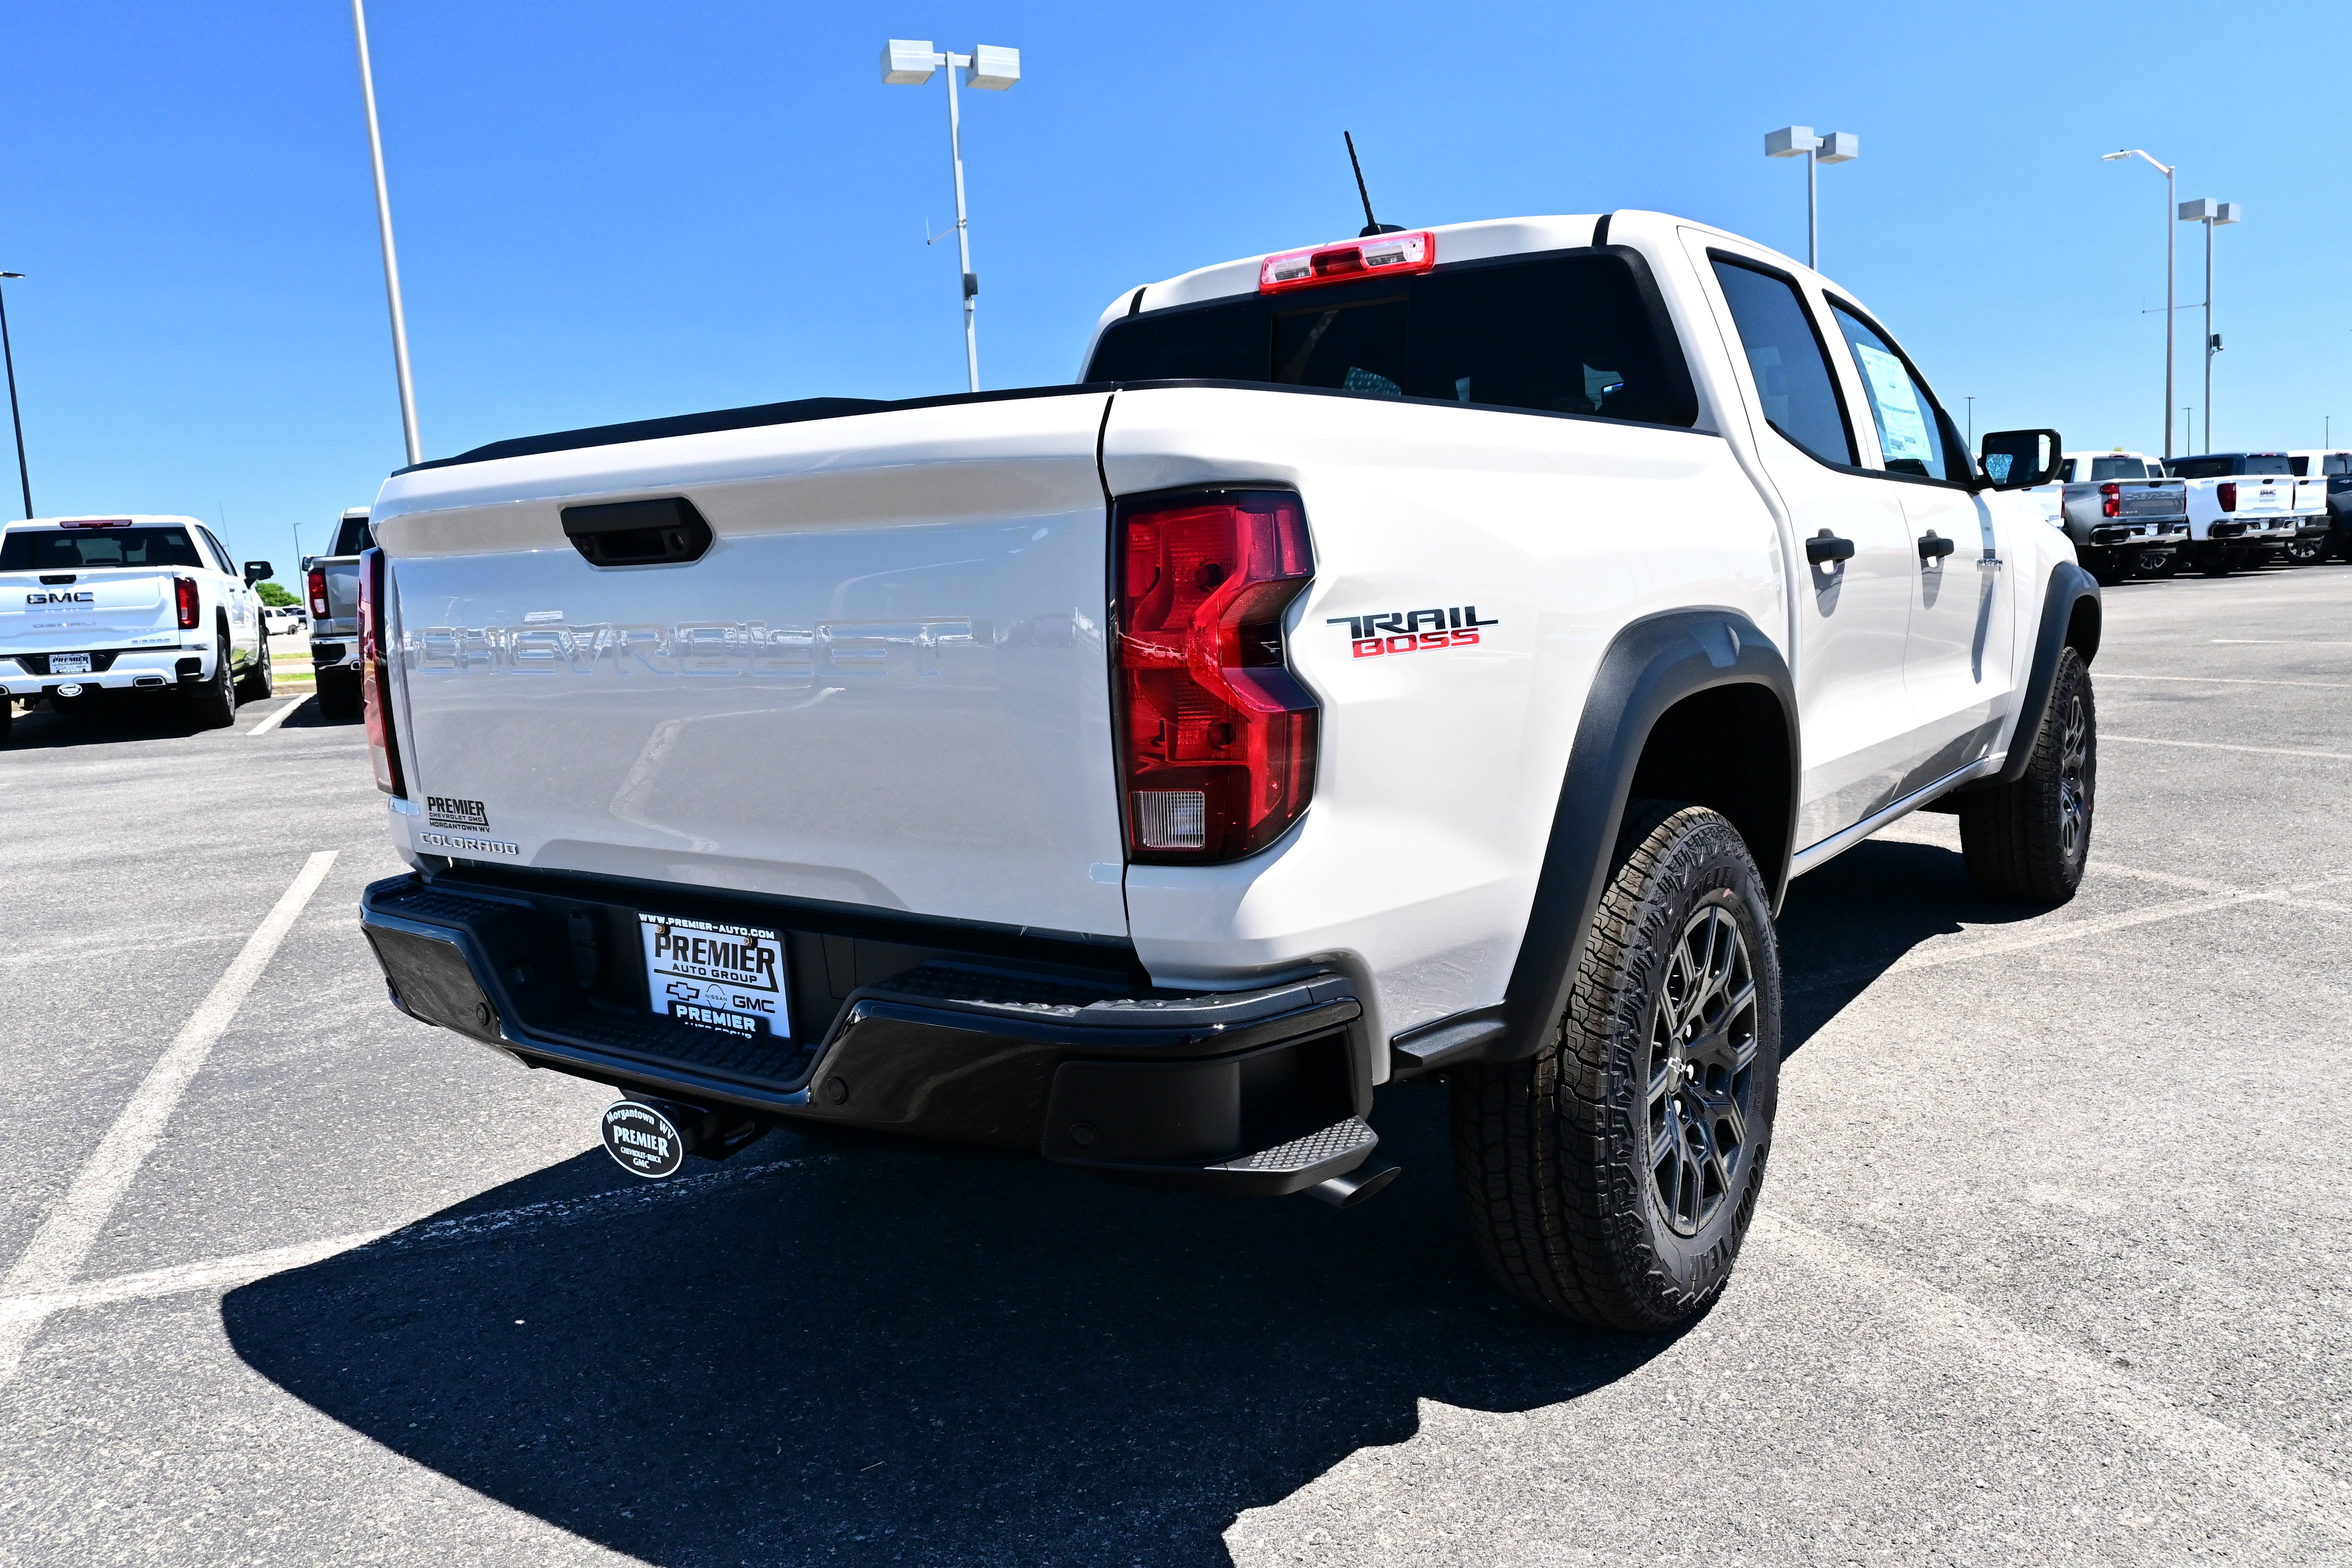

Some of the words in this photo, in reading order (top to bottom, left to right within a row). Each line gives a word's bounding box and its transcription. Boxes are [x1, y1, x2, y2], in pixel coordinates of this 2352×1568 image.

[27, 592, 94, 604] GMC
[1326, 605, 1499, 639] TRAIL
[414, 616, 972, 677] CHEVROLET
[1352, 628, 1480, 659] BOSS
[427, 797, 488, 824] PREMIER
[429, 812, 466, 820] CHEVROLET
[430, 821, 477, 831] MORGANTOWN
[420, 832, 519, 855] COLORADO
[638, 913, 775, 939] WWW.PREMIER-AUTO.COM
[655, 933, 778, 988] PREMIER
[672, 963, 706, 976] AUTO
[712, 969, 757, 983] GROUP
[705, 994, 727, 1002] NISSAN
[733, 995, 776, 1013] GMC
[676, 1005, 756, 1032] PREMIER
[606, 1108, 654, 1125] Morgantown
[660, 1120, 674, 1140] WV
[613, 1125, 670, 1157] PREMIER
[633, 1158, 650, 1169] GMC
